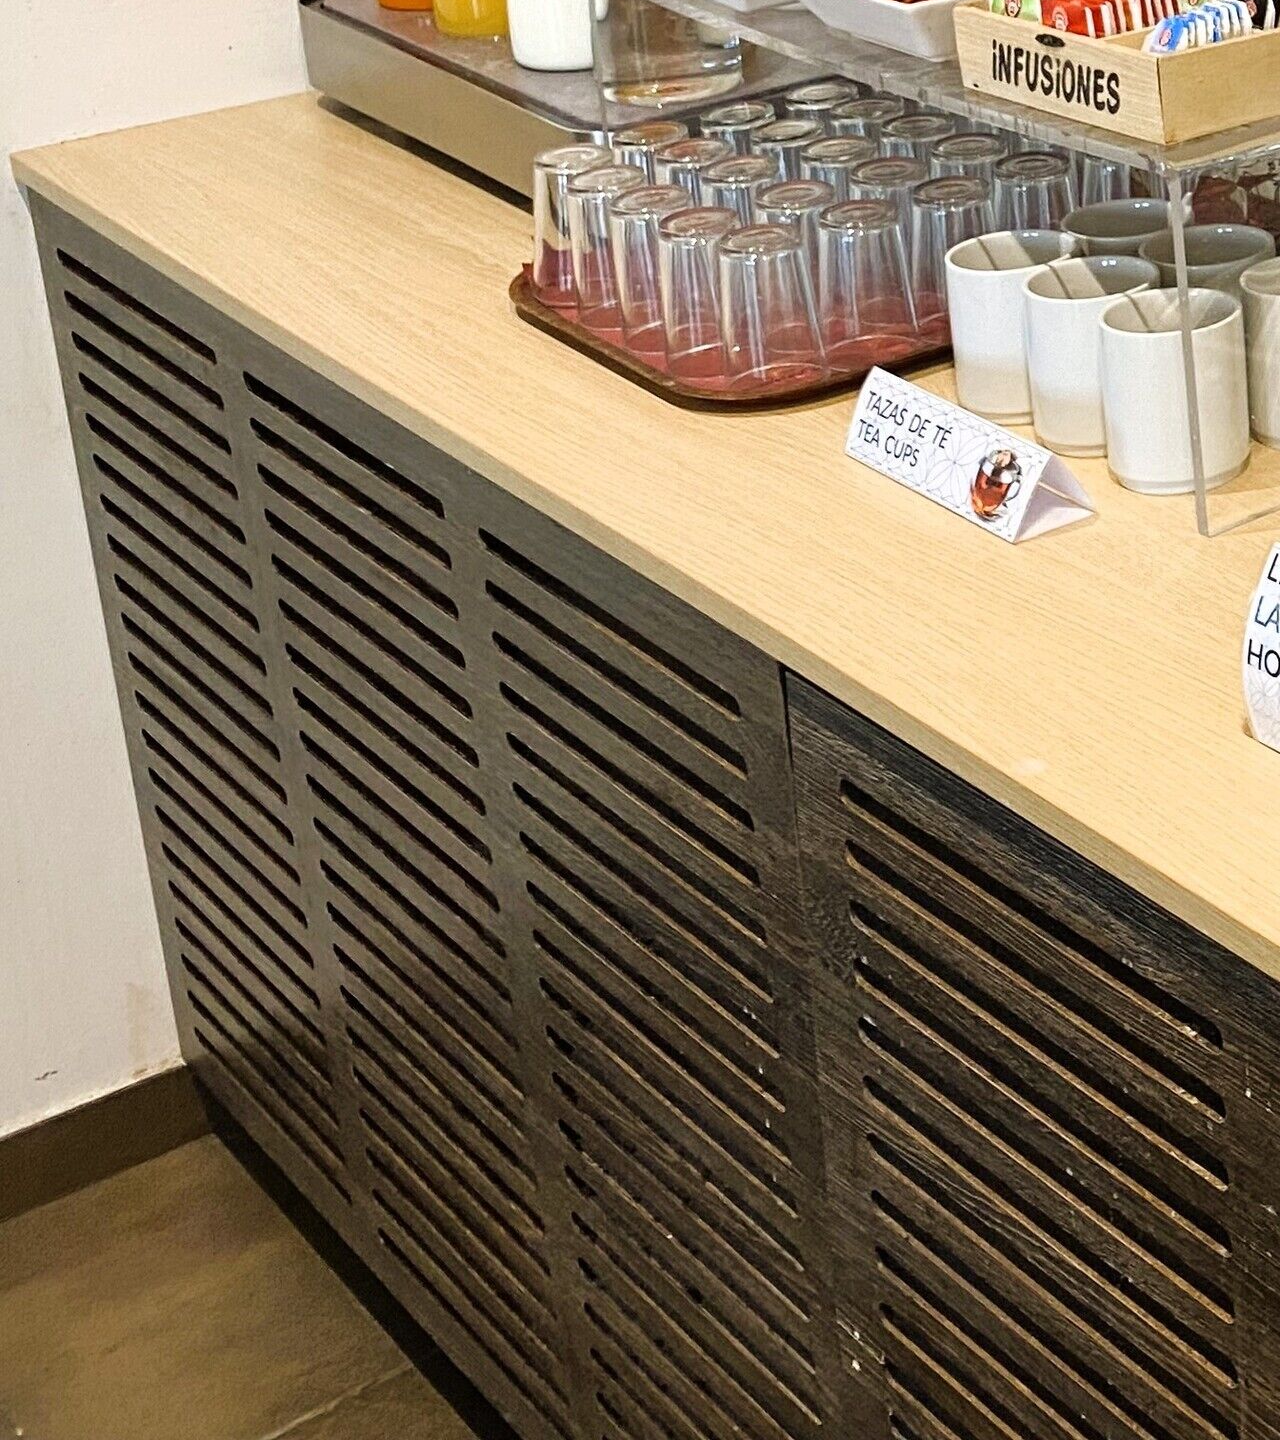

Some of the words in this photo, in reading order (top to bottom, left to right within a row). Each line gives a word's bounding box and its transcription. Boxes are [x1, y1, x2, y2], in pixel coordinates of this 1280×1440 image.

[857, 418, 880, 447] TEA
[884, 434, 920, 468] CUPS
[866, 390, 908, 427] TAZAS
[908, 413, 932, 439] DE
[935, 424, 952, 450] TÉ
